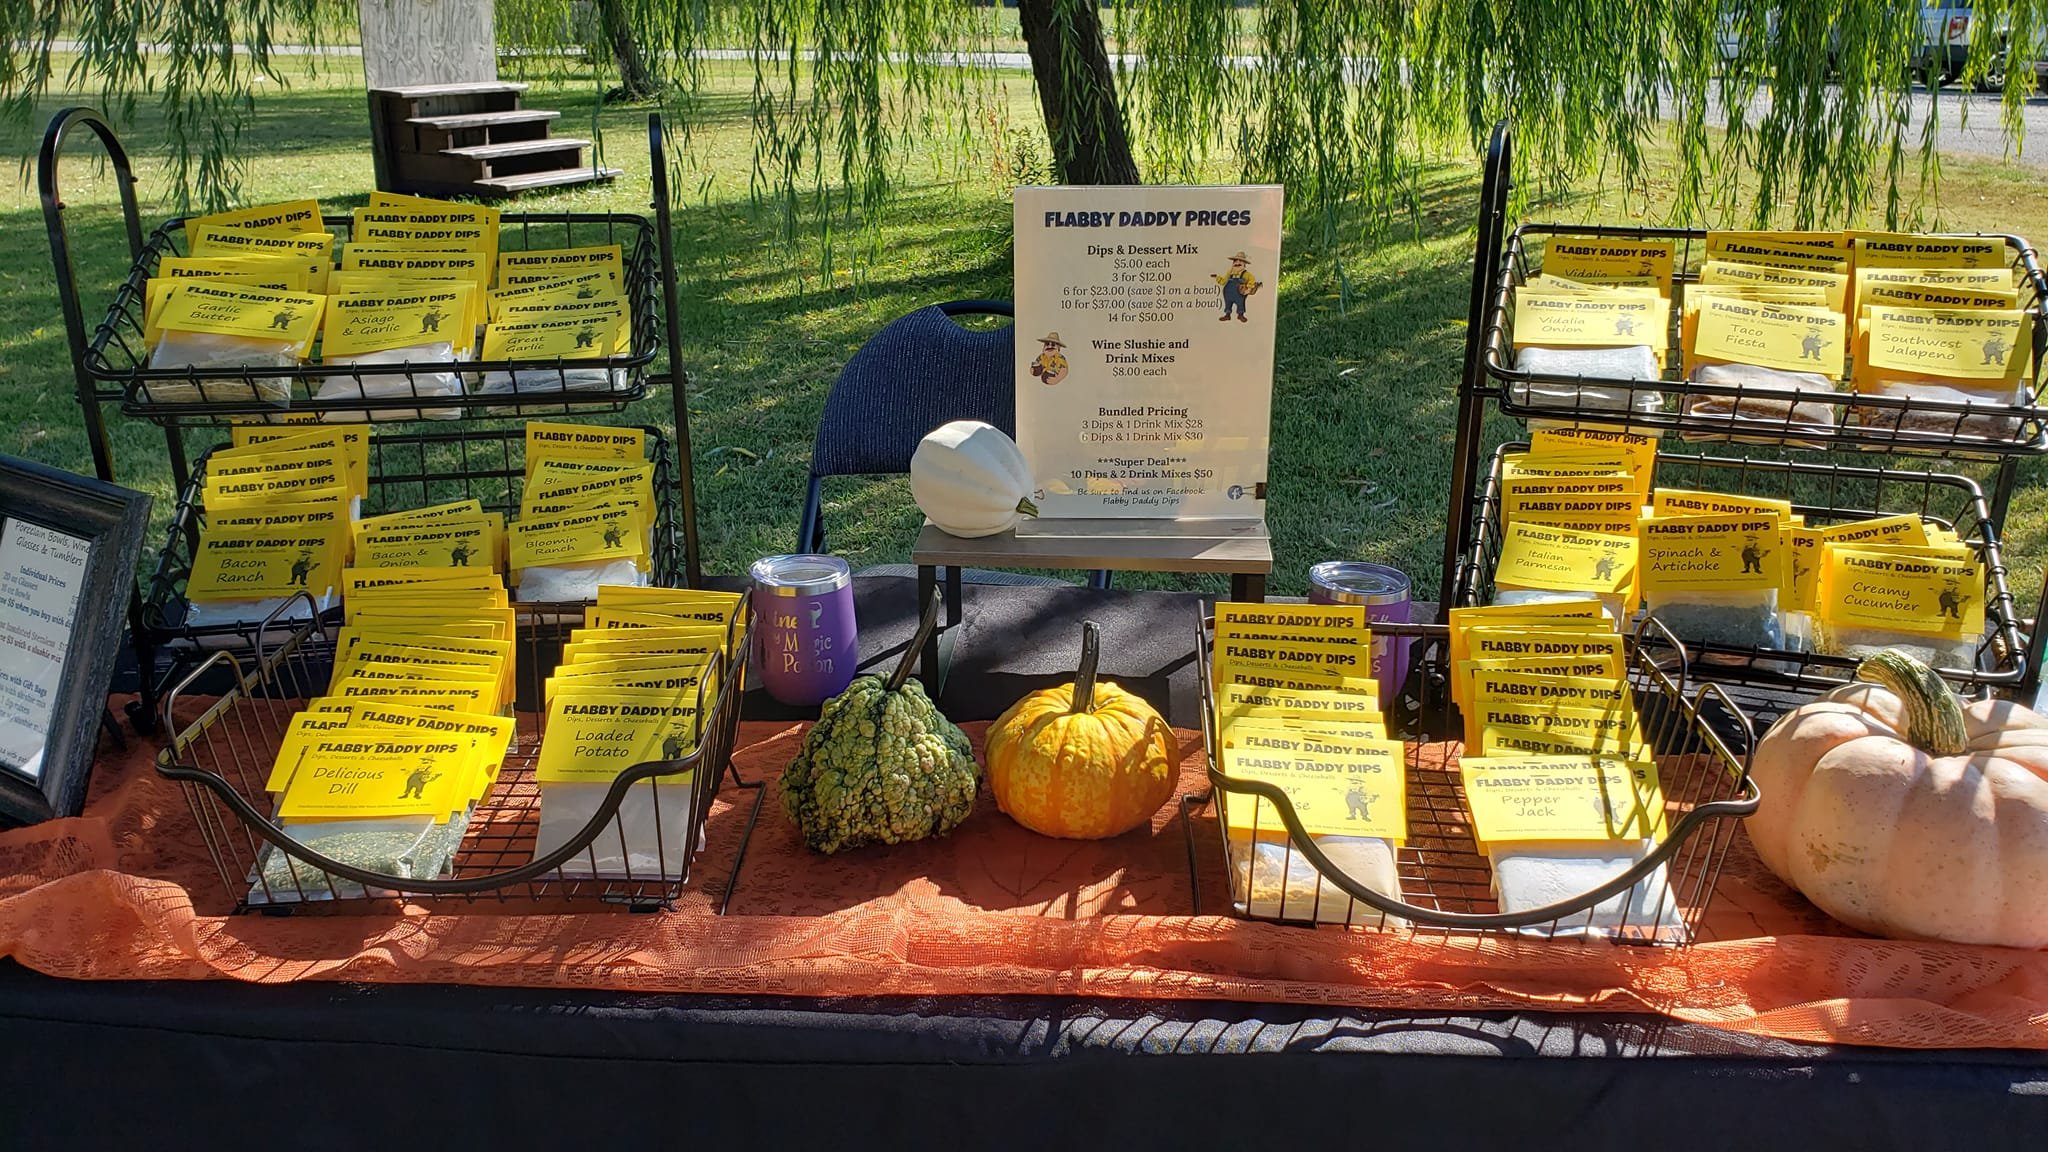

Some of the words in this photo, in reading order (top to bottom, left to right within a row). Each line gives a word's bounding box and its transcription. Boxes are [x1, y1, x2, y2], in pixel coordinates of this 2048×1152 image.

[1045, 212, 1115, 227] FLABBY
[1119, 211, 1181, 226] DADDY
[1088, 245, 1113, 257] Dips
[1117, 245, 1125, 254] &
[1128, 245, 1172, 254] Dessert
[1176, 244, 1198, 254] Mix
[1866, 242, 1912, 252] FLABBY
[1916, 244, 1961, 253] DADDY
[1963, 245, 1992, 253] DIPS
[1114, 259, 1142, 269] $5.00
[1146, 259, 1170, 268] each
[1121, 272, 1136, 282] for
[1139, 272, 1171, 282] $12.00
[1072, 286, 1088, 295] for
[1090, 286, 1124, 296] $23.00
[1128, 286, 1153, 297] (save
[1156, 286, 1166, 296] $1
[1194, 285, 1221, 297] bowl)
[338, 300, 382, 309] FLABBY
[387, 297, 426, 306] DADDY
[429, 293, 456, 303] DIPS
[1061, 300, 1071, 309] 10
[1074, 299, 1090, 309] for
[1092, 300, 1124, 310] $37.00
[1128, 299, 1153, 310] (save
[1156, 299, 1168, 309] $2
[1195, 299, 1222, 311] bowl)
[197, 302, 241, 314] Garlic
[190, 311, 240, 322] Butter
[350, 314, 395, 325] Asiago
[1108, 313, 1118, 322] 14
[1121, 312, 1136, 322] for
[1139, 312, 1174, 323] $50.00
[1539, 316, 1585, 325] Vidalia
[342, 328, 353, 336] &
[360, 323, 400, 335] Garlic
[1542, 325, 1583, 333] Onion
[1731, 324, 1764, 337] Taco
[507, 336, 545, 344] Great
[1092, 340, 1121, 350] Wine
[1124, 340, 1165, 350] Slushie
[1168, 340, 1189, 349] and
[1725, 335, 1766, 349] Fiesta
[1881, 333, 1962, 349] Southwest
[505, 343, 544, 353] Garlic
[1886, 346, 1955, 360] Jalapeno
[1106, 353, 1138, 364] Drink
[1142, 353, 1175, 363] Mixes
[1113, 367, 1140, 376] $8.00
[1143, 367, 1167, 376] each
[1099, 407, 1144, 416] Bundled
[1147, 407, 1188, 418] Pricing
[1092, 420, 1114, 431] Dips
[1116, 421, 1124, 429] &
[1134, 420, 1161, 428] Drink
[1164, 420, 1183, 428] Mix
[1186, 420, 1203, 429] $28
[533, 431, 573, 442] FLABBY
[575, 433, 611, 444] DADDY
[613, 434, 636, 445] DIPS
[1091, 432, 1113, 444] Dips
[1116, 433, 1124, 441] &
[1133, 432, 1160, 441] Drink
[1164, 432, 1182, 441] Mix
[1185, 432, 1203, 442] $30
[1071, 471, 1082, 479] 10
[1085, 470, 1107, 481] Dips
[1130, 470, 1158, 478] Drink
[1161, 470, 1191, 478] Mixes
[1194, 470, 1212, 479] $50
[1103, 497, 1129, 506] Flabby
[1132, 497, 1159, 506] Daddy
[1162, 497, 1179, 505] Dips
[16, 521, 45, 538] Porcelain
[1648, 525, 1694, 534] FLABBY
[1698, 524, 1740, 533] DADDY
[1742, 522, 1770, 531] DIPS
[525, 535, 578, 549] Bloomin
[16, 536, 40, 552] Glasses
[41, 545, 48, 554] &
[50, 548, 83, 566] Tumblers
[371, 549, 413, 561] Bacon
[416, 548, 428, 557] &
[535, 544, 576, 556] Ranch
[1528, 550, 1564, 562] Italian
[1648, 548, 1703, 560] Spinach
[1709, 548, 1721, 557] &
[220, 558, 267, 569] Bacon
[379, 558, 419, 568] Onion
[1516, 558, 1572, 572] Parmesan
[1651, 560, 1720, 572] Artichoke
[48, 575, 66, 588] Prices
[216, 571, 264, 583] Ranch
[1852, 582, 1910, 600] Creamy
[1844, 595, 1919, 612] Cucumber
[1226, 646, 1276, 659] FLABBY
[1278, 651, 1322, 663] DADDY
[1326, 654, 1356, 665] DIPS
[576, 729, 635, 742] Loaded
[318, 743, 372, 753] FLABBY
[374, 743, 423, 754] DADDY
[424, 743, 458, 753] DIPS
[574, 745, 629, 758] Potato
[313, 766, 385, 780] Delicious
[328, 783, 358, 795] Dill
[1501, 794, 1561, 807] Pepper
[1516, 807, 1557, 817] Jack
